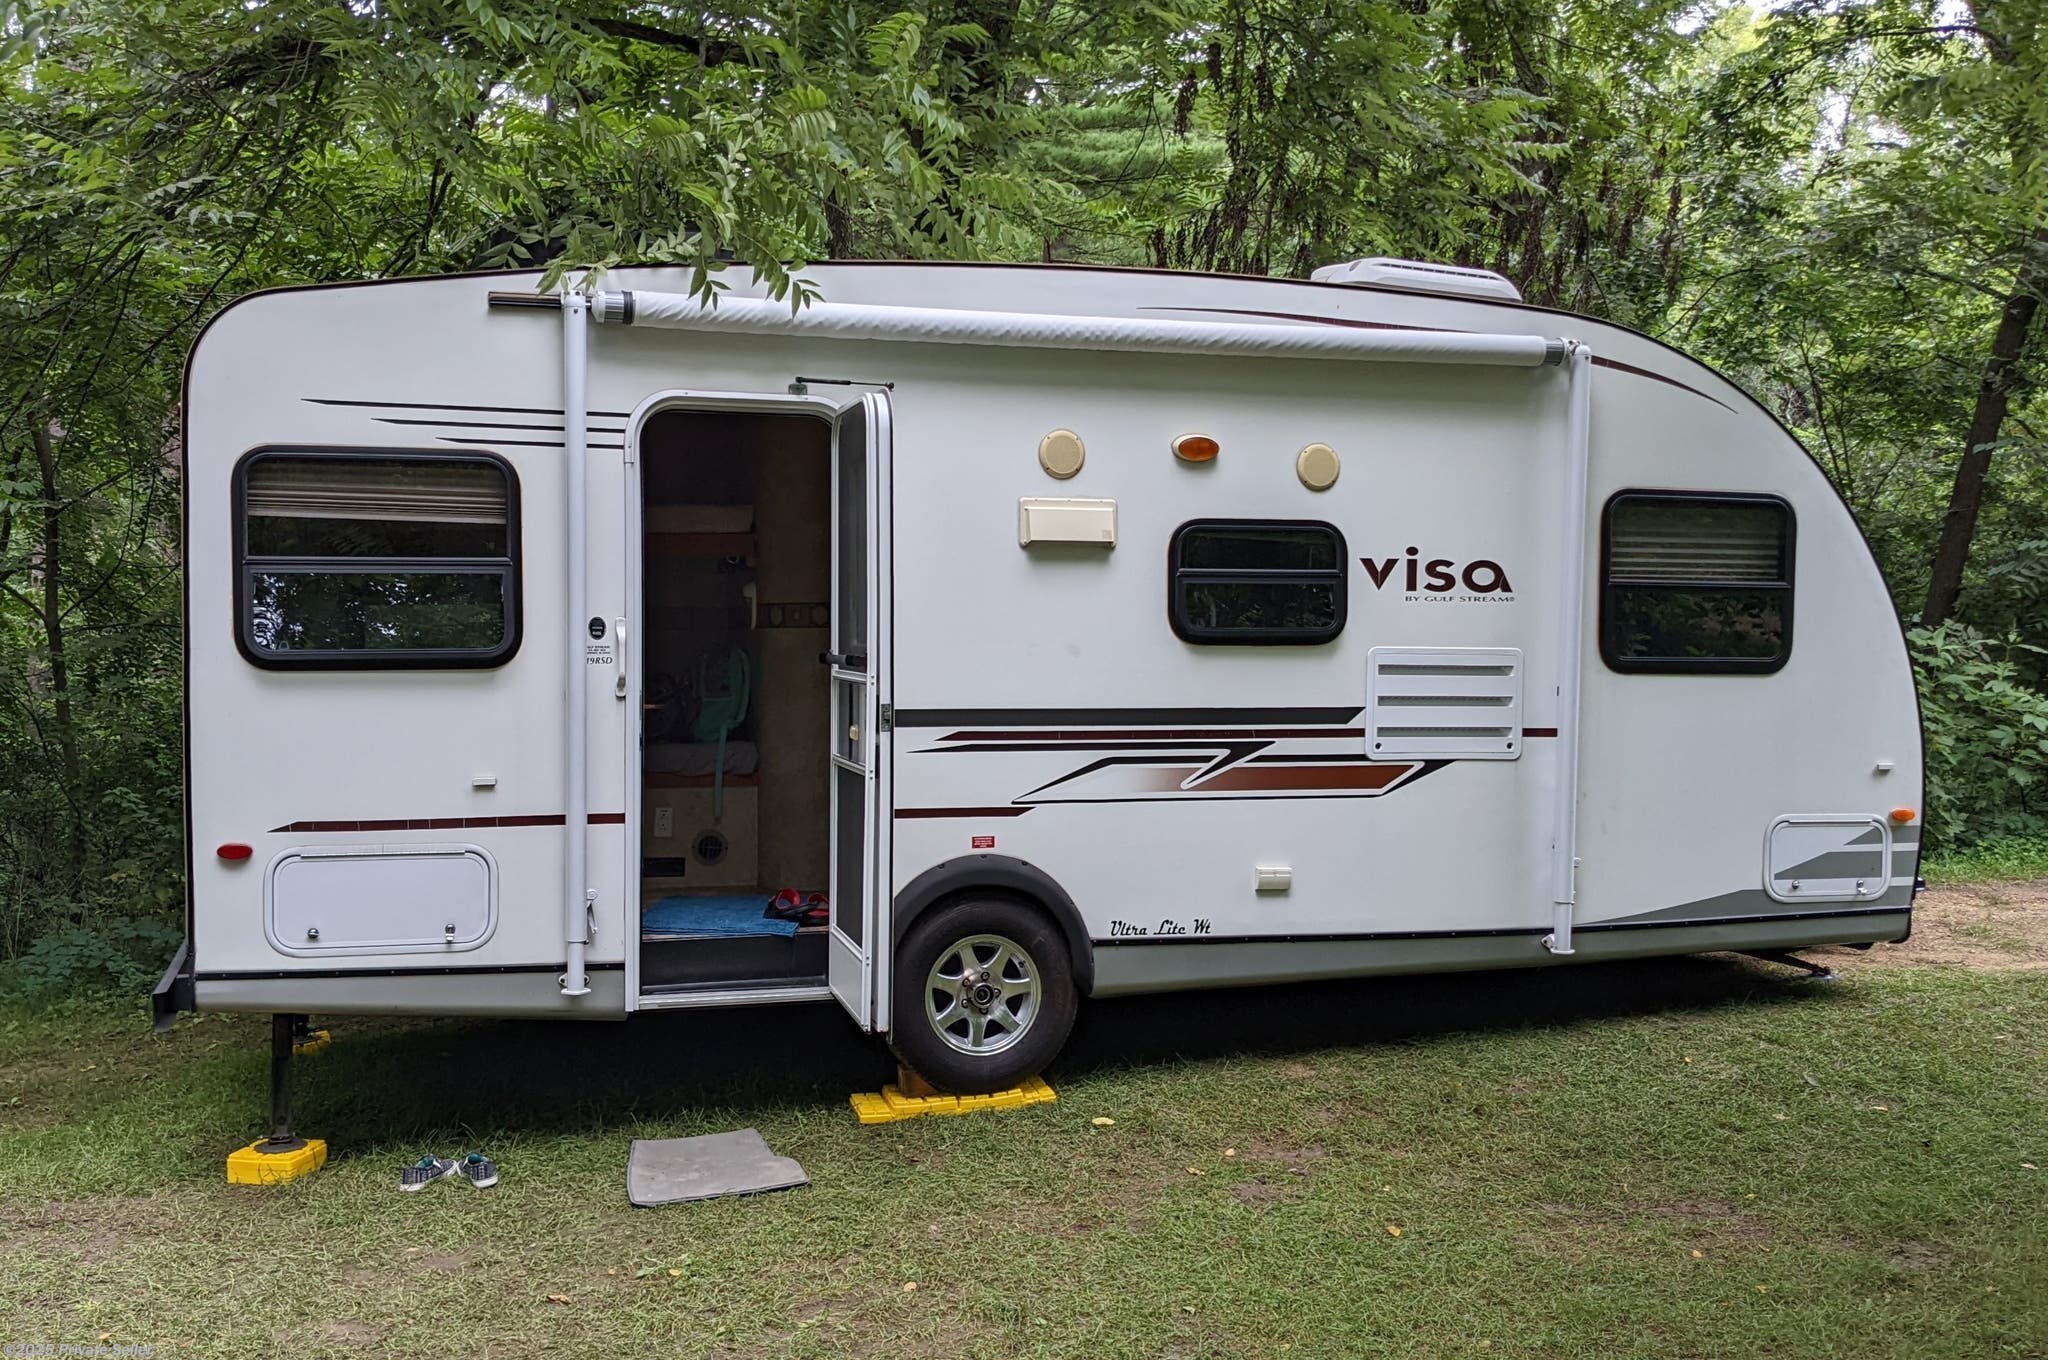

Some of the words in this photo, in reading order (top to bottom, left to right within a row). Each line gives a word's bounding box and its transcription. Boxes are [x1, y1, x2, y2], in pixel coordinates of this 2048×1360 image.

[1359, 546, 1513, 594] visa
[586, 656, 613, 665] 19RSD
[1110, 920, 1148, 936] Ultra
[1153, 919, 1187, 935] Lite
